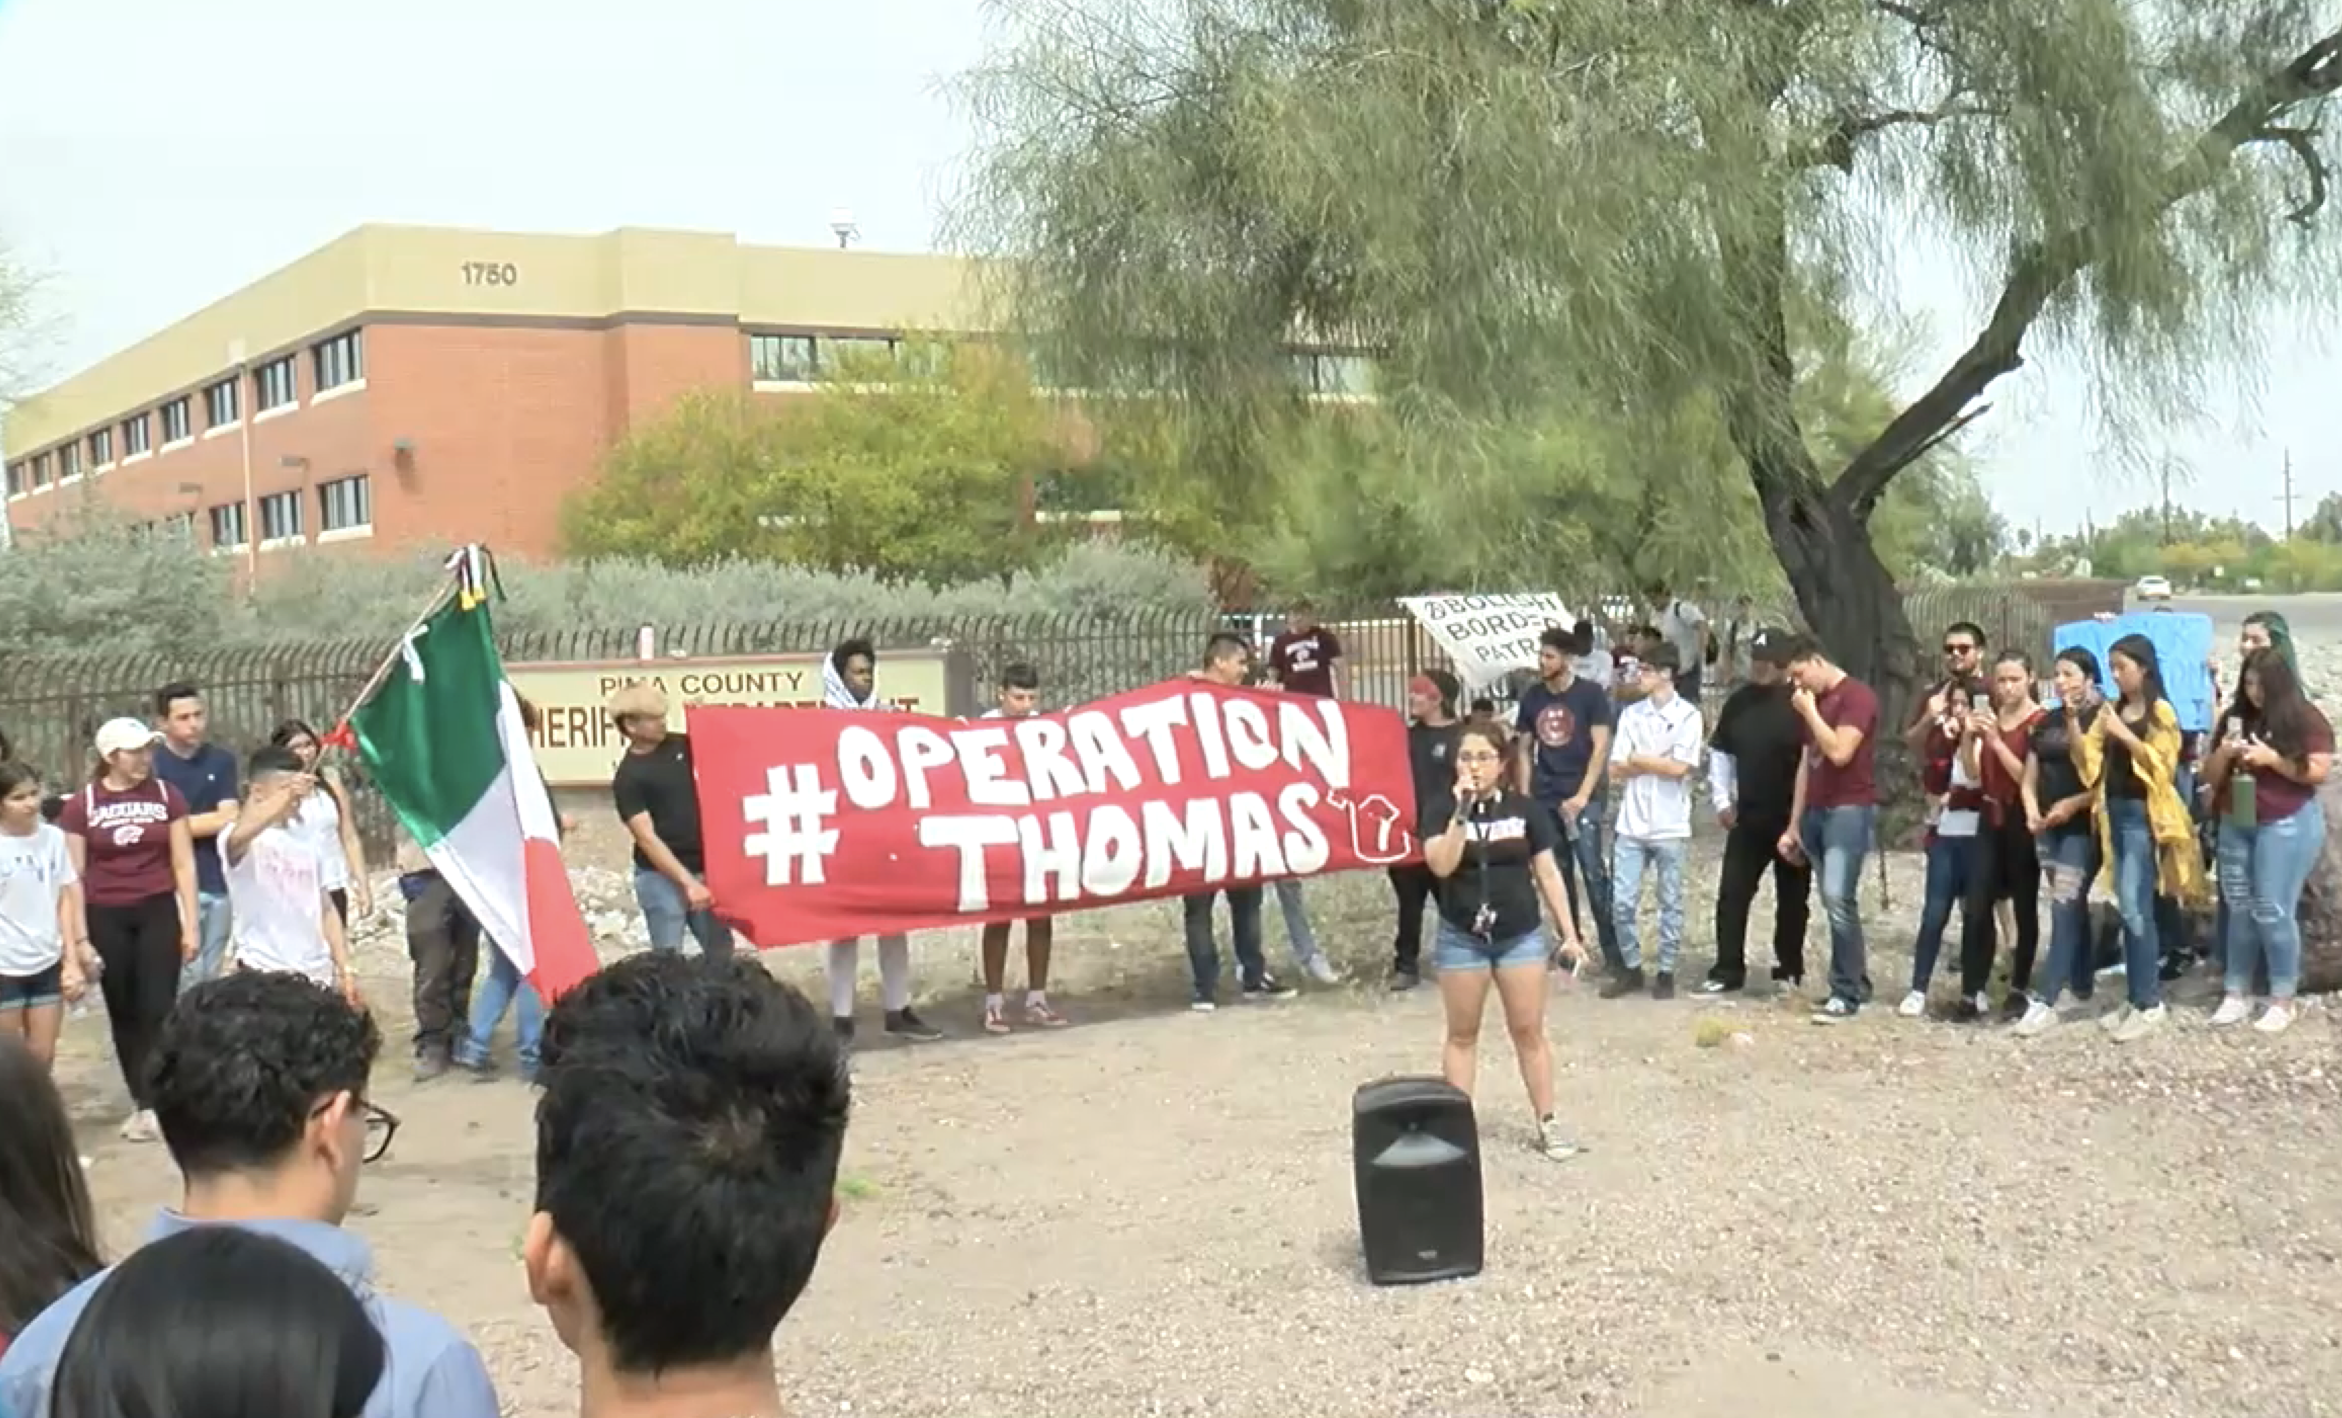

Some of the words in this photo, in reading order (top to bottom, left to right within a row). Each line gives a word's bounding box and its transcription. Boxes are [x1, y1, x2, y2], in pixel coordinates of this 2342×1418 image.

[461, 261, 517, 287] 1750
[1475, 637, 1540, 662] PATR
[680, 671, 804, 695] COUNTY
[919, 782, 1330, 912] THOMAS
